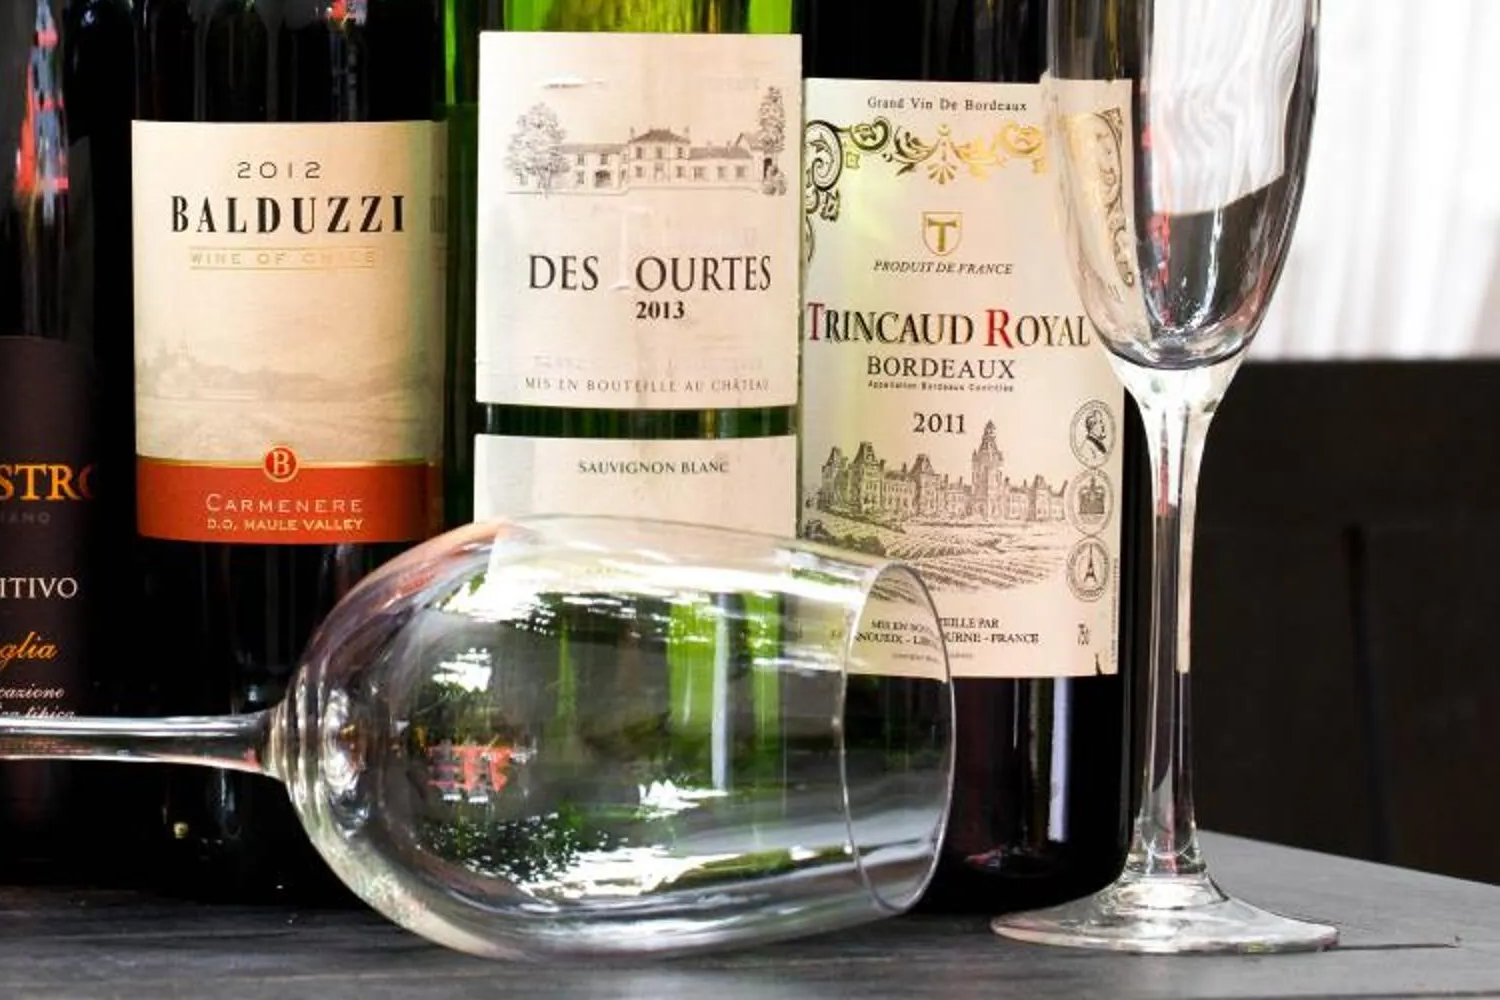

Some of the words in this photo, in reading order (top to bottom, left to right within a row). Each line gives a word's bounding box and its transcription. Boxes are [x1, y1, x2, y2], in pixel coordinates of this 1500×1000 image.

[867, 96, 905, 110] Grand
[910, 97, 934, 111] Vin
[940, 98, 958, 112] De
[965, 99, 1028, 113] Bordeaux
[237, 161, 322, 180] 2012
[170, 194, 405, 235] BALDUZZI
[190, 252, 242, 266] WINE
[256, 252, 286, 266] OF
[301, 252, 375, 267] CHE
[873, 259, 934, 275] PRODUIT
[935, 262, 956, 274] DE
[957, 262, 1014, 276] FRANCE
[528, 254, 600, 292] DES
[634, 300, 686, 320] 2013
[807, 302, 975, 347] TRINCAUD
[983, 308, 1092, 350] ROYAL
[866, 355, 1016, 380] BORDEAUX
[524, 376, 551, 390] MIS
[559, 378, 578, 391] EN
[586, 378, 677, 393] BOUTEILLE
[684, 379, 703, 393] AU
[912, 411, 966, 435] 2011
[578, 460, 676, 475] SAUVIGNON
[680, 460, 730, 474] BLANC
[205, 492, 364, 514] CARMENERE
[303, 519, 364, 532] VALLEY
[979, 617, 999, 630] PAR
[990, 633, 1040, 645] FRANCE
